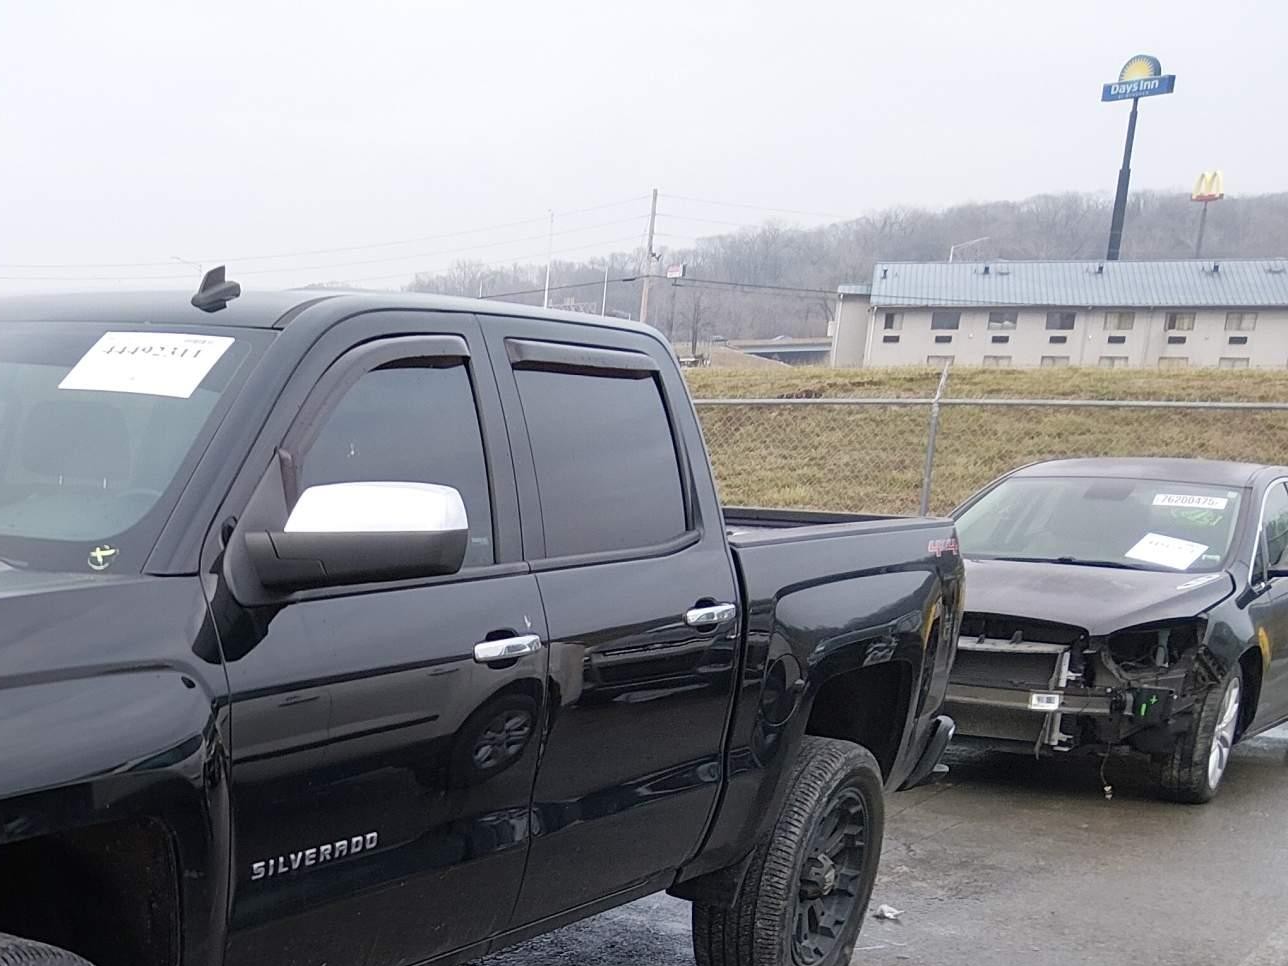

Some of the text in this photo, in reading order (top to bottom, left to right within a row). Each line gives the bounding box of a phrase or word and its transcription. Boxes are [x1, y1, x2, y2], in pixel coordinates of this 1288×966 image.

[1110, 81, 1139, 95] Days
[1139, 79, 1160, 91] Inn
[251, 831, 378, 881] SILVERADO
